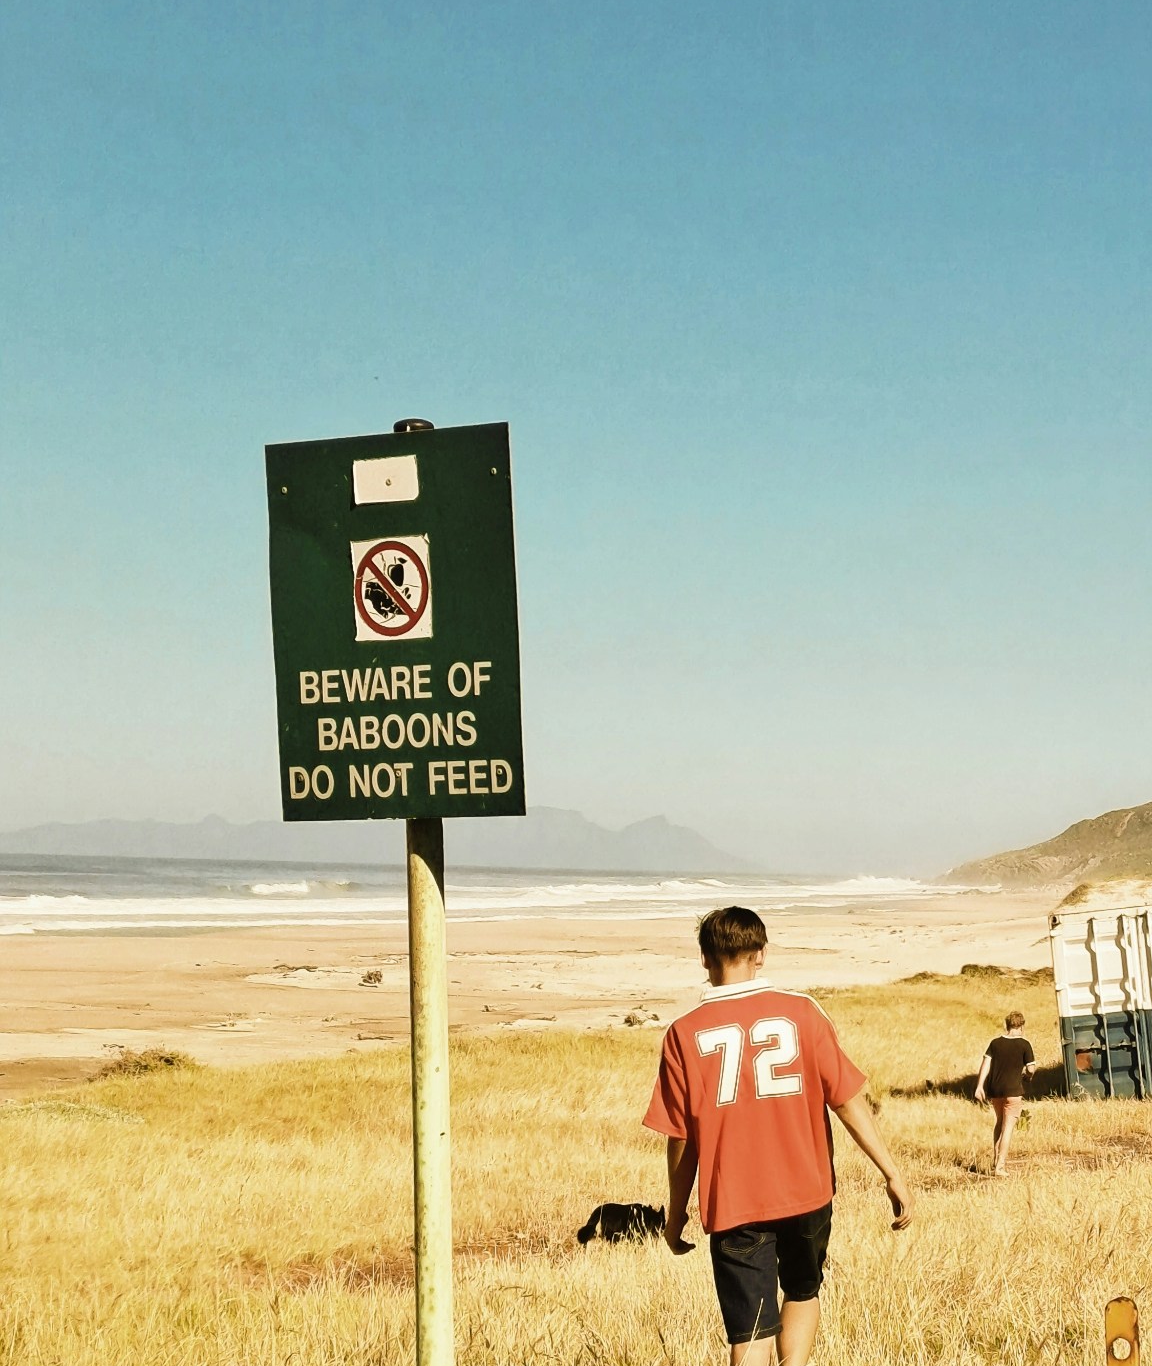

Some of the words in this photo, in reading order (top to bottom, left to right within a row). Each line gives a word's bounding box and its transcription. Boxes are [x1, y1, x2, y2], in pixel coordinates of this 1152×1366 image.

[299, 664, 433, 705] BEWARE
[447, 661, 492, 698] OF
[317, 710, 478, 752] BABOONS
[288, 764, 335, 800] DO
[348, 762, 414, 798] NOT
[428, 759, 514, 796] FEED
[694, 1016, 803, 1108] 72
